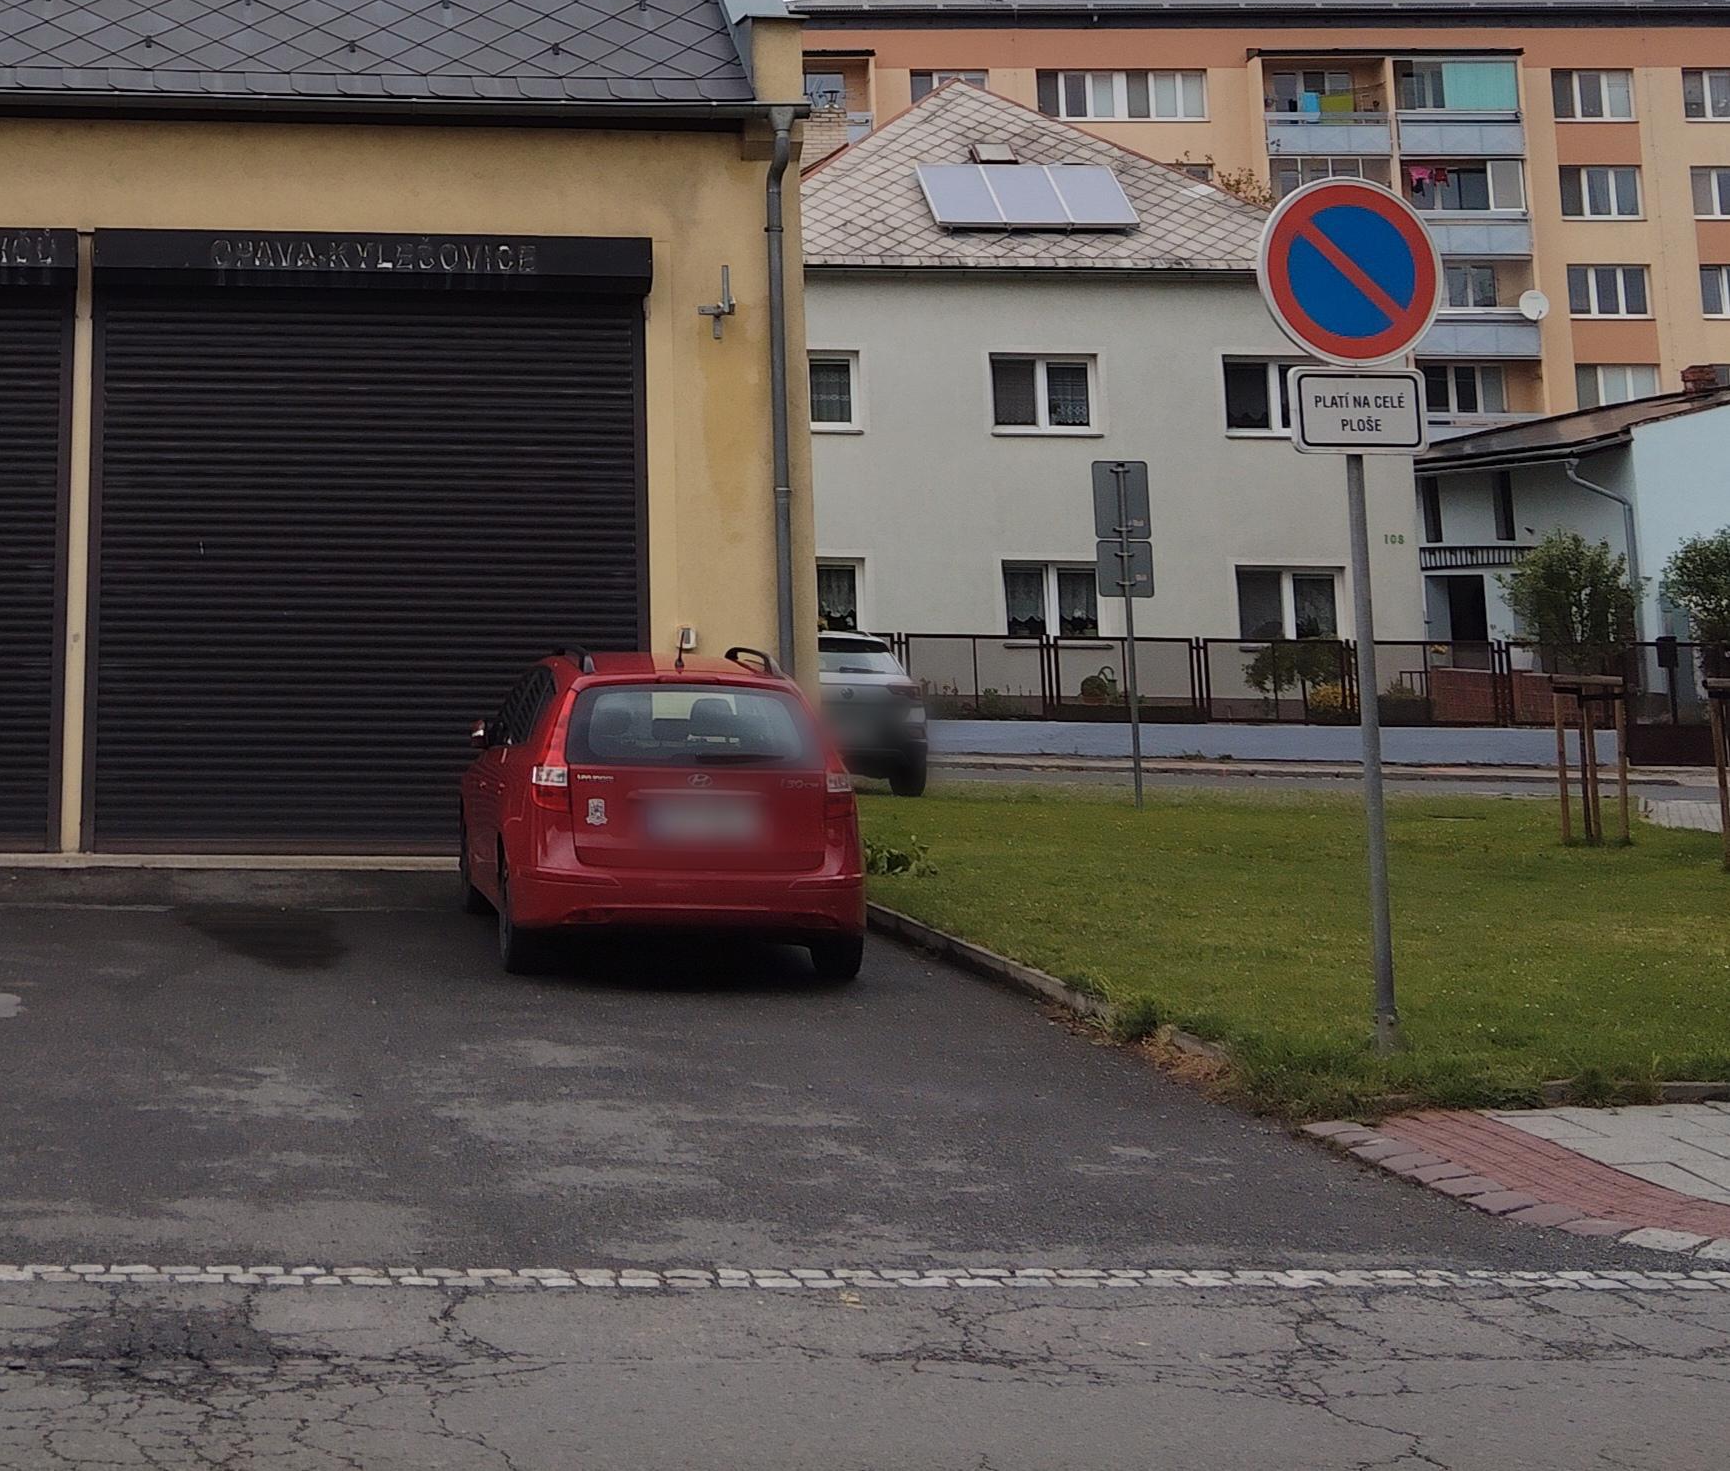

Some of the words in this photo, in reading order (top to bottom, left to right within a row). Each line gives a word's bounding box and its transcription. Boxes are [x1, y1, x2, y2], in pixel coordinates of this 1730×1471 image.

[1314, 392, 1349, 409] PLATÍ
[1353, 395, 1370, 409] NA
[1374, 393, 1406, 409] CELÉ
[1341, 416, 1382, 432] PLOŠE
